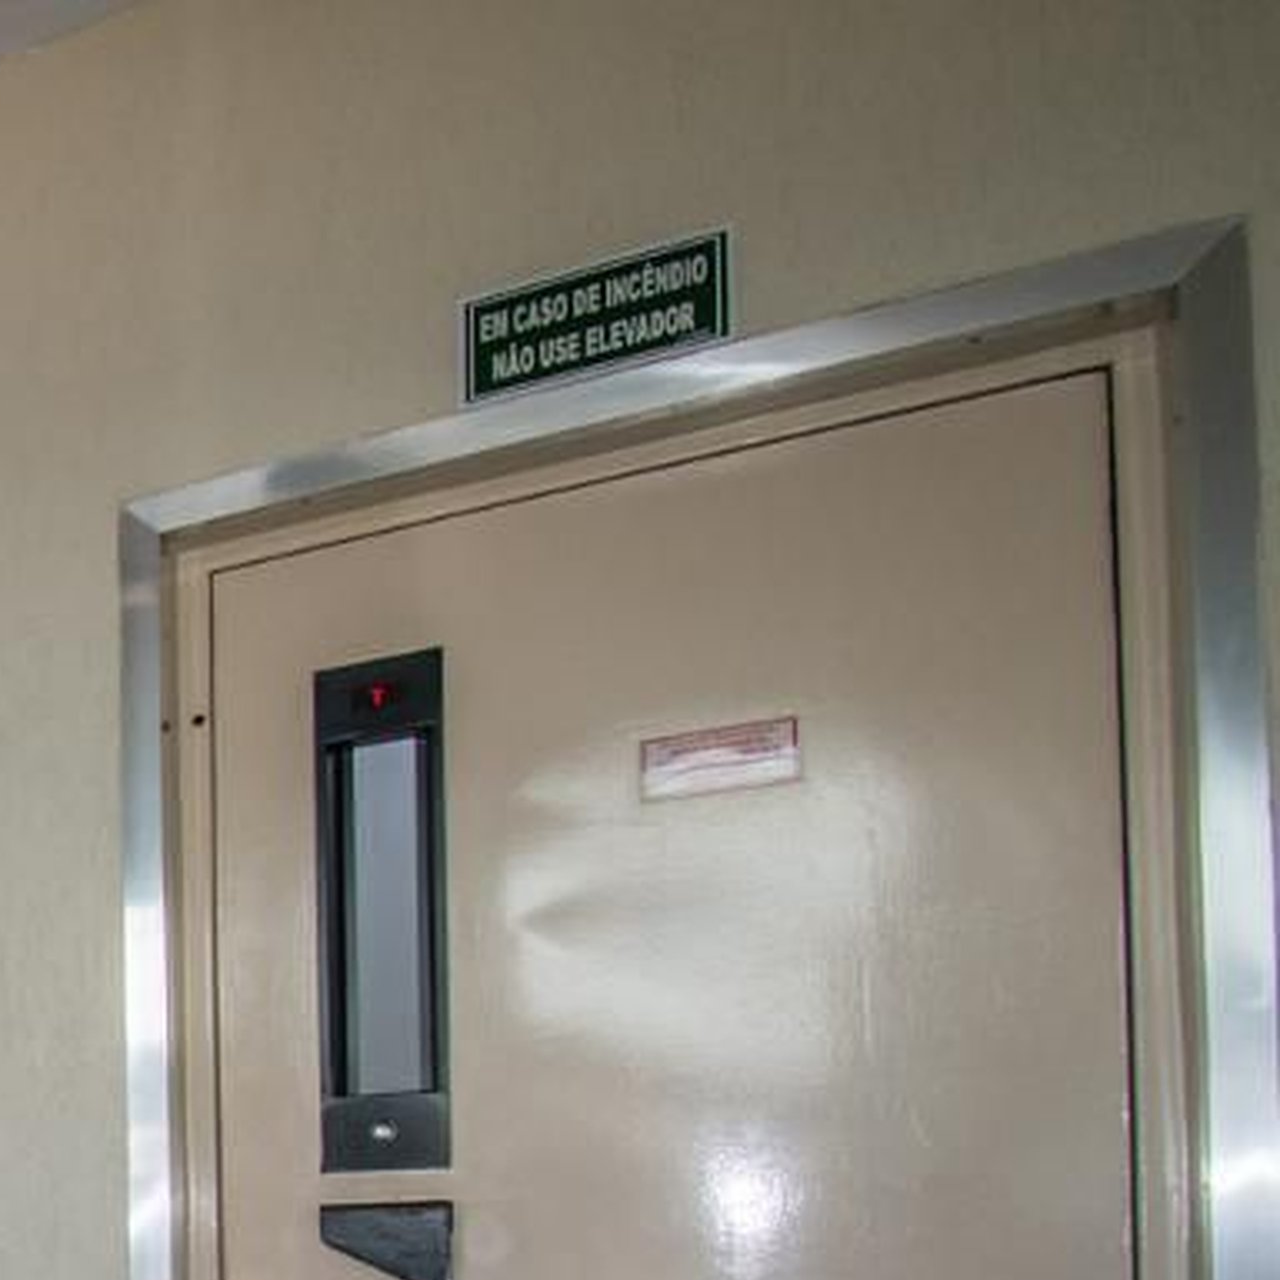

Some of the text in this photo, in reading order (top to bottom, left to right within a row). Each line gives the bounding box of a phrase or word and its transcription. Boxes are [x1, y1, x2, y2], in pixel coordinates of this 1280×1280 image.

[480, 255, 708, 342] EM CASO DE INCÊNDIO
[492, 302, 695, 382] NÃO USE ELEVADOR
